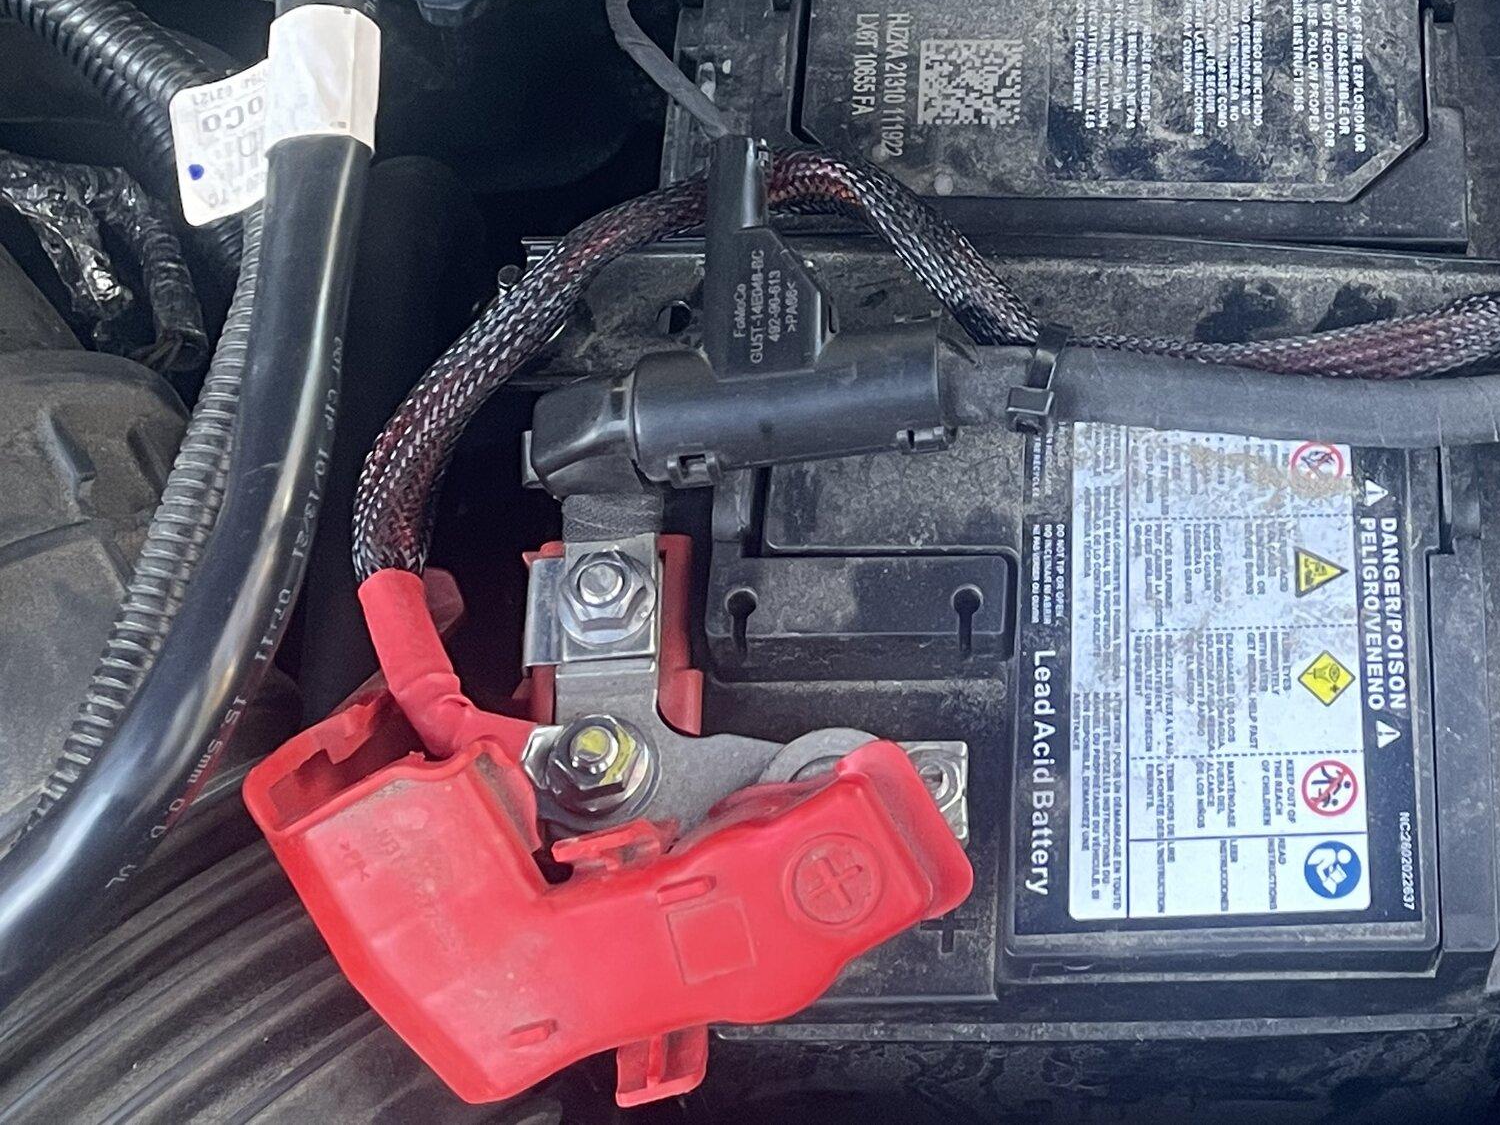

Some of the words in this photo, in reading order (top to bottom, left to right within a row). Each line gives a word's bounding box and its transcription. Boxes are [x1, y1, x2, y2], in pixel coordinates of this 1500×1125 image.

[1351, 16, 1362, 32] OF
[1205, 58, 1216, 73] DE
[1252, 60, 1263, 74] DE
[1308, 32, 1319, 81] FOLLOW
[853, 51, 878, 93] 10655
[883, 62, 908, 103] 21310
[1322, 29, 1334, 121] RECOMMENDED
[1337, 32, 1349, 114] DISASSEMBLE
[851, 95, 876, 115] FA
[1205, 74, 1216, 114] SEGUIR
[1309, 82, 1320, 132] PROPER
[1353, 65, 1365, 133] EXPLOSION
[1217, 96, 1228, 128] COMO
[881, 108, 905, 156] 111922
[1324, 122, 1336, 147] FOR
[1339, 117, 1350, 135] OR
[1354, 134, 1366, 152] OR
[733, 283, 747, 338] FoMoCo
[1043, 523, 1052, 538] NO
[1055, 523, 1065, 538] DO
[1055, 538, 1065, 558] NOT
[1055, 575, 1065, 591] OR
[1380, 517, 1407, 710] DANGER/POISON
[1247, 632, 1256, 651] GET
[1033, 648, 1056, 716] Lead
[1248, 697, 1258, 723] HELP
[1249, 724, 1259, 750] FAST
[1032, 720, 1056, 784] Acid
[1262, 759, 1270, 772] OF
[1216, 761, 1225, 793] FUERA
[1274, 760, 1283, 779] THE
[1286, 758, 1295, 785] KEEP
[1197, 777, 1205, 796] LOS
[1206, 761, 1215, 807] ALCANCE
[1287, 787, 1296, 807] OUT
[1166, 794, 1175, 821] HORS
[1262, 775, 1272, 826] CHILDREN
[1275, 780, 1284, 816] REACH
[1287, 809, 1296, 824] OF
[1024, 789, 1056, 896] Battery
[1229, 838, 1239, 863] LEER
[1277, 837, 1287, 865] READ
